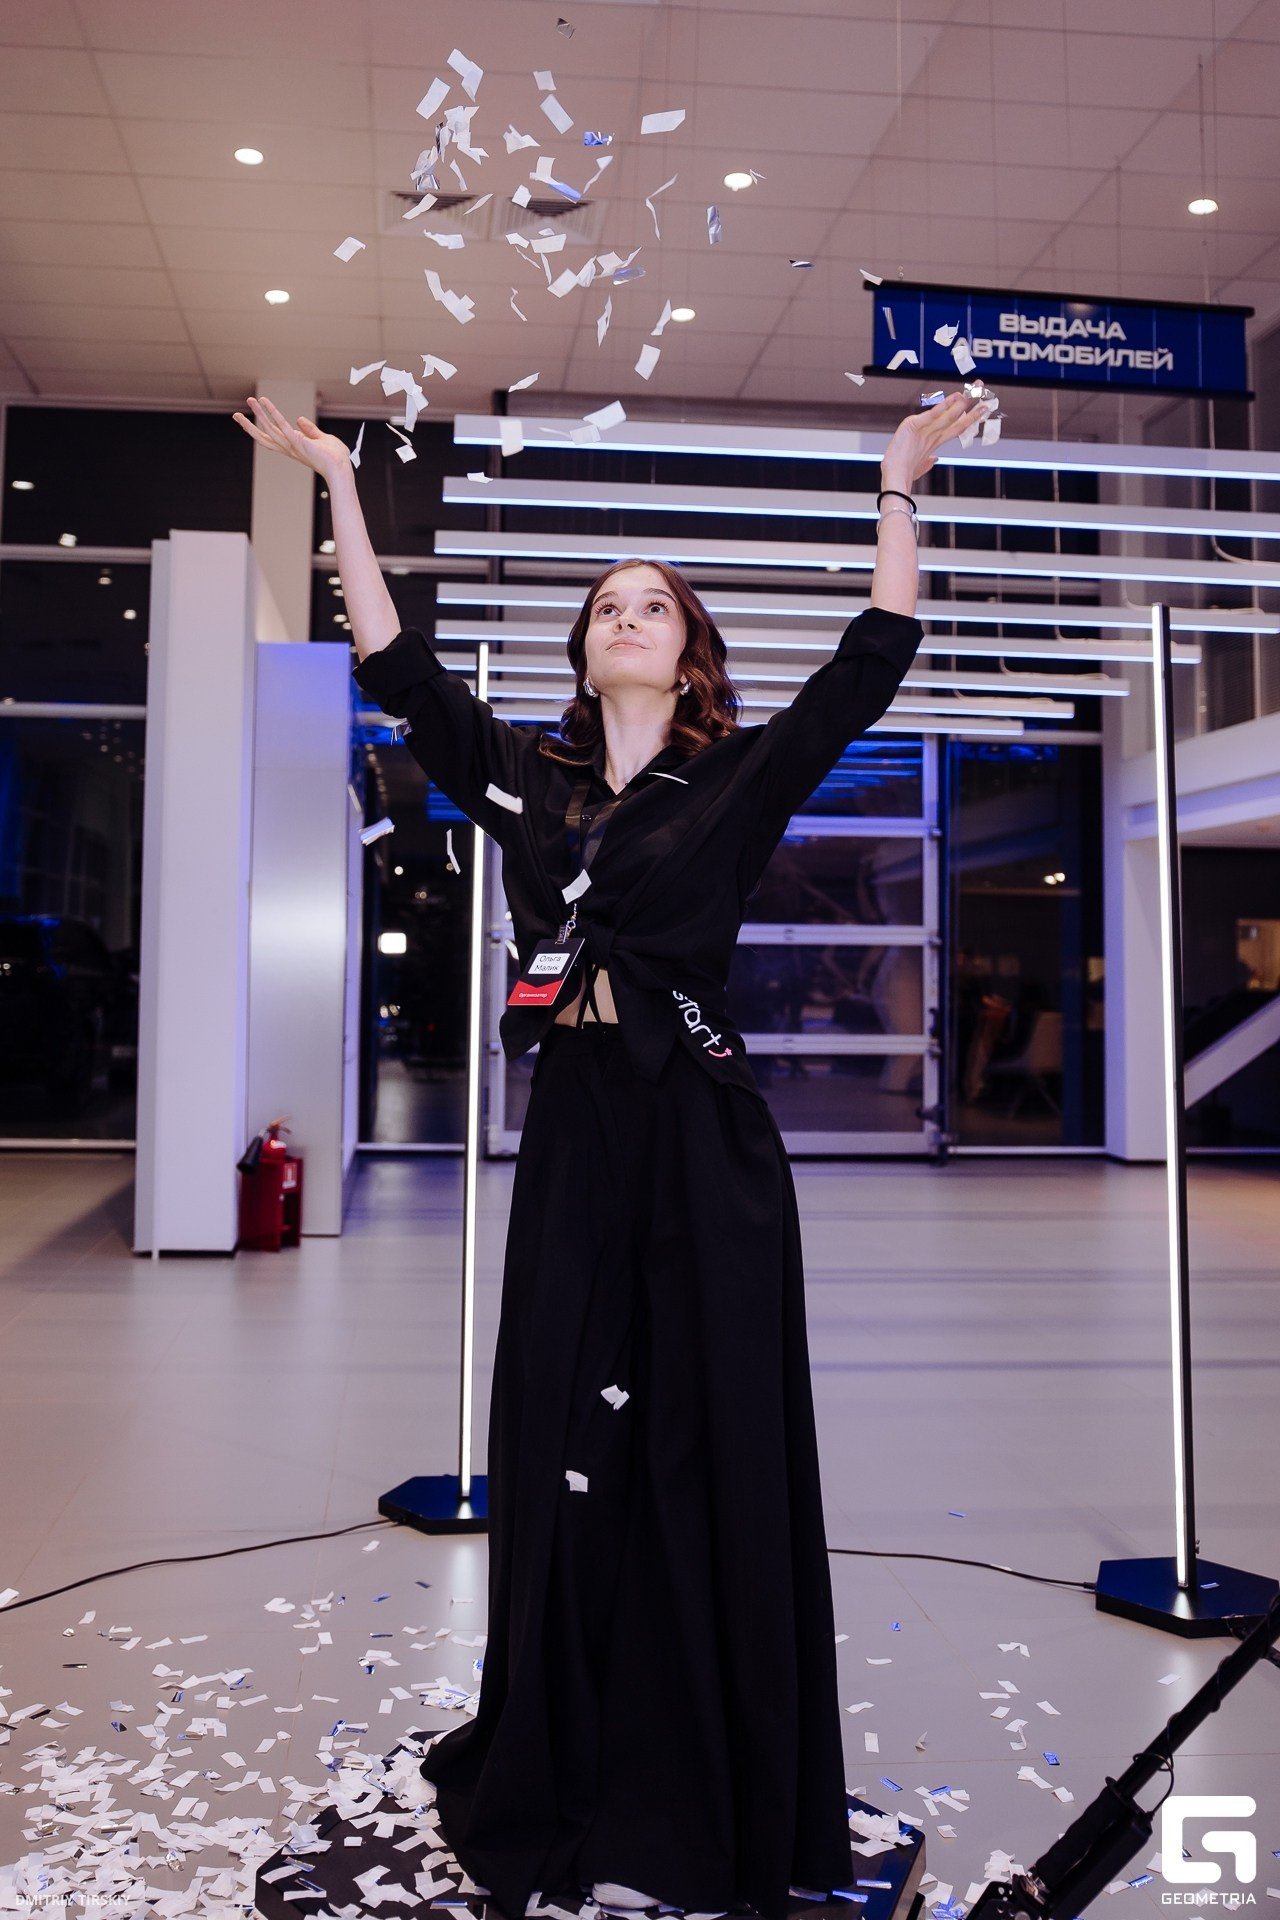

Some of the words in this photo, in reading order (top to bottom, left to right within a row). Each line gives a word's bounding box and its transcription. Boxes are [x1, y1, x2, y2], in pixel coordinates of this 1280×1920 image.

[999, 313, 1127, 341] ВЫДАЧА
[539, 955, 562, 963] Ольга
[534, 964, 560, 972] Малик
